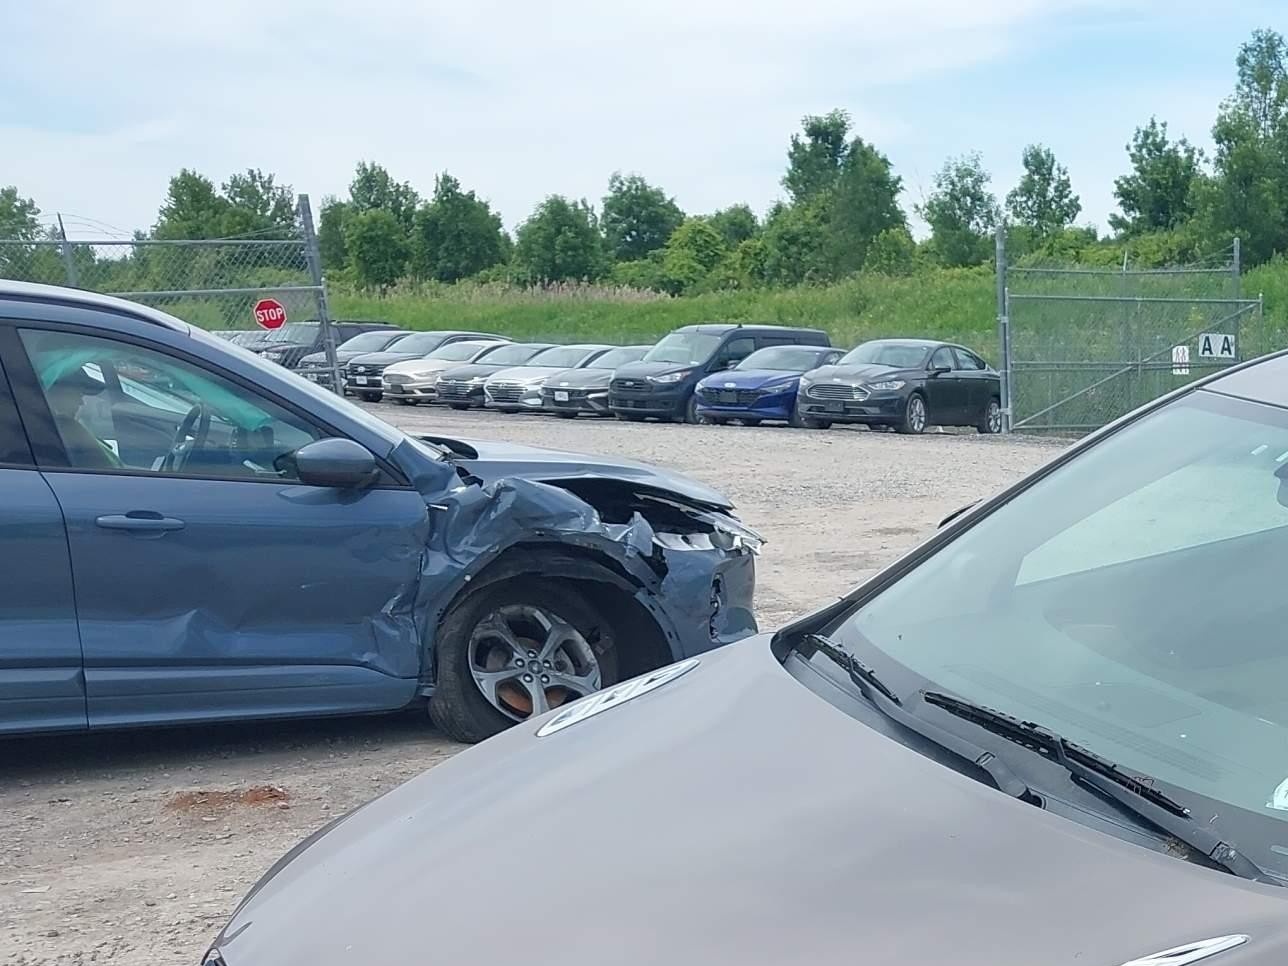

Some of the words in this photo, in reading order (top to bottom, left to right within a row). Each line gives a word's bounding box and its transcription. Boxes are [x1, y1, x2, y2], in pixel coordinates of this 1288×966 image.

[257, 308, 283, 322] STOP
[1201, 335, 1213, 355] A
[1220, 335, 1232, 355] A
